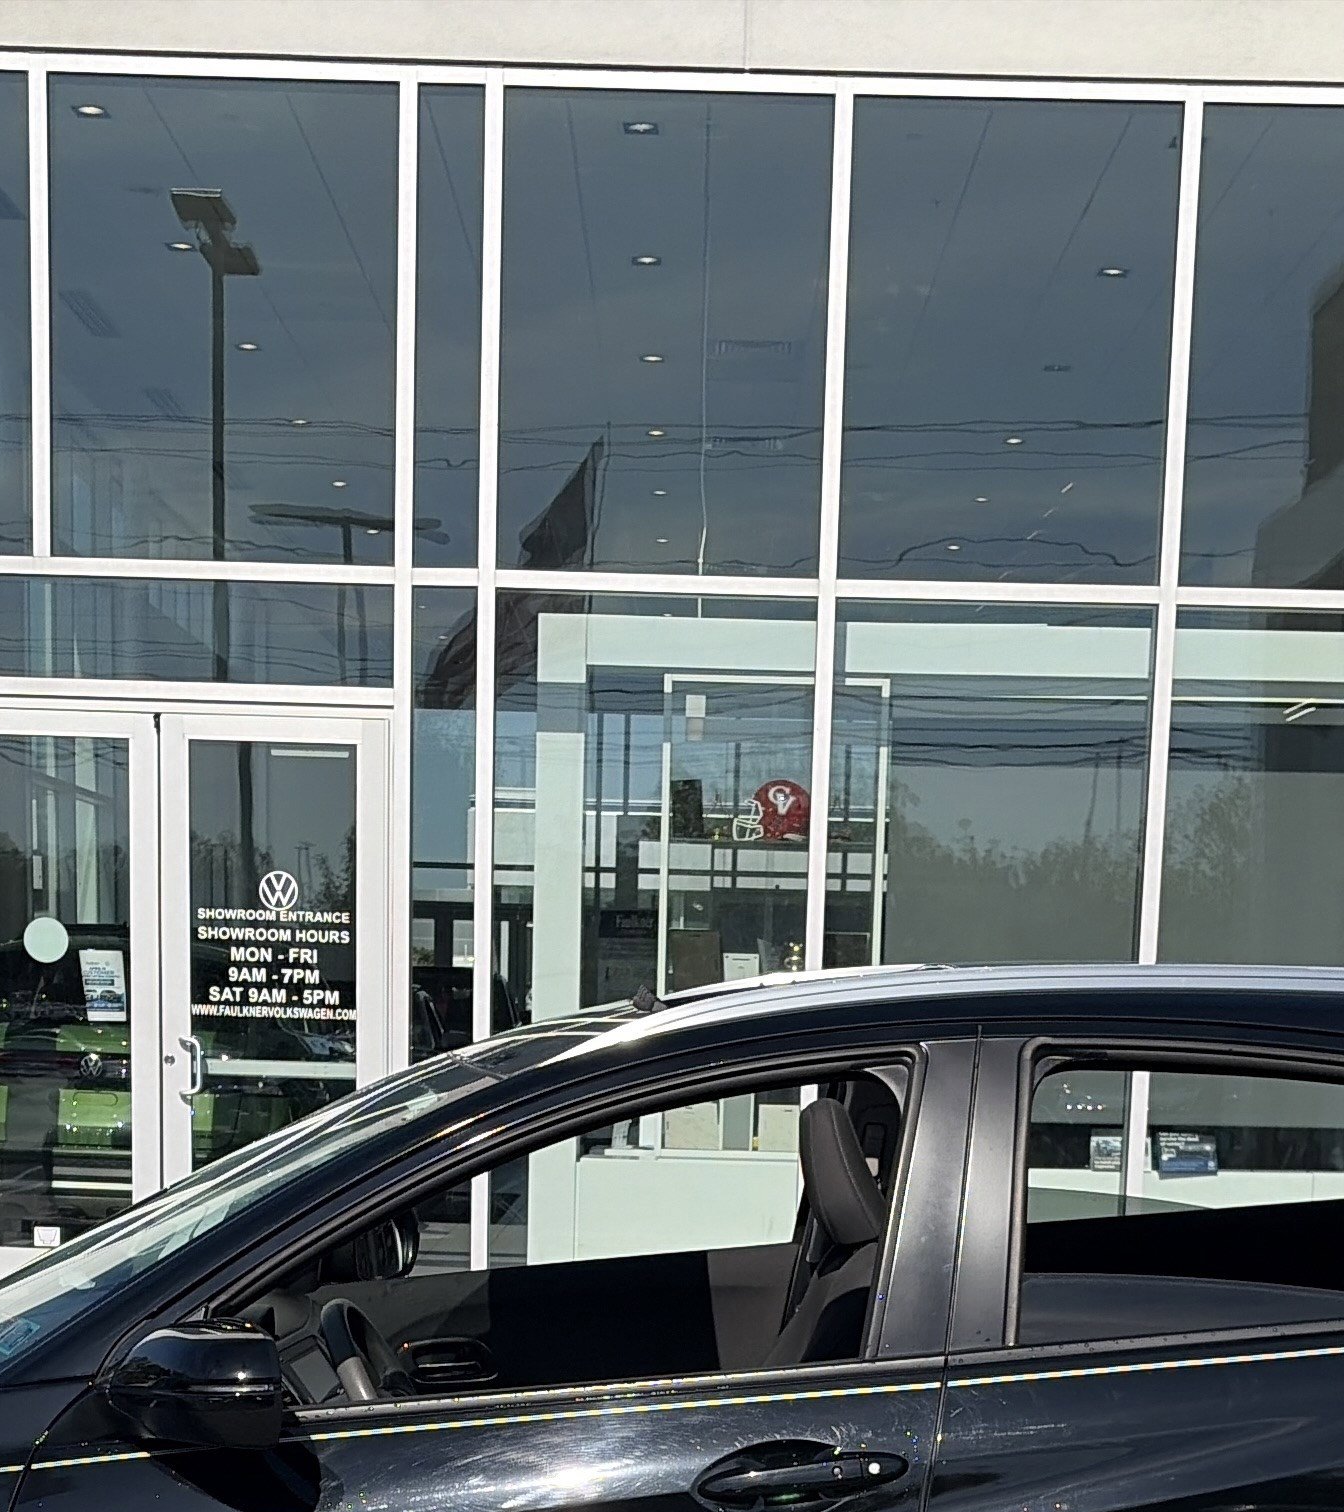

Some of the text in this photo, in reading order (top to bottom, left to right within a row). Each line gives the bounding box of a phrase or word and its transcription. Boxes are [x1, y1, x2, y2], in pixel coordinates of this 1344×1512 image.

[259, 870, 298, 911] VW
[197, 908, 350, 924] SHOWROOM ENTRANCE
[197, 926, 350, 944] SHOWROOM HOURS
[230, 947, 273, 963] MON
[288, 949, 318, 964] FRI
[228, 967, 267, 983] 9AM
[281, 969, 320, 984] 7PM
[208, 986, 244, 1002] SAT
[248, 988, 287, 1004] 9AM
[303, 990, 340, 1005] 5PM
[191, 1004, 356, 1021] WWW.FAULKNERVOLKSWAGEN.COM
